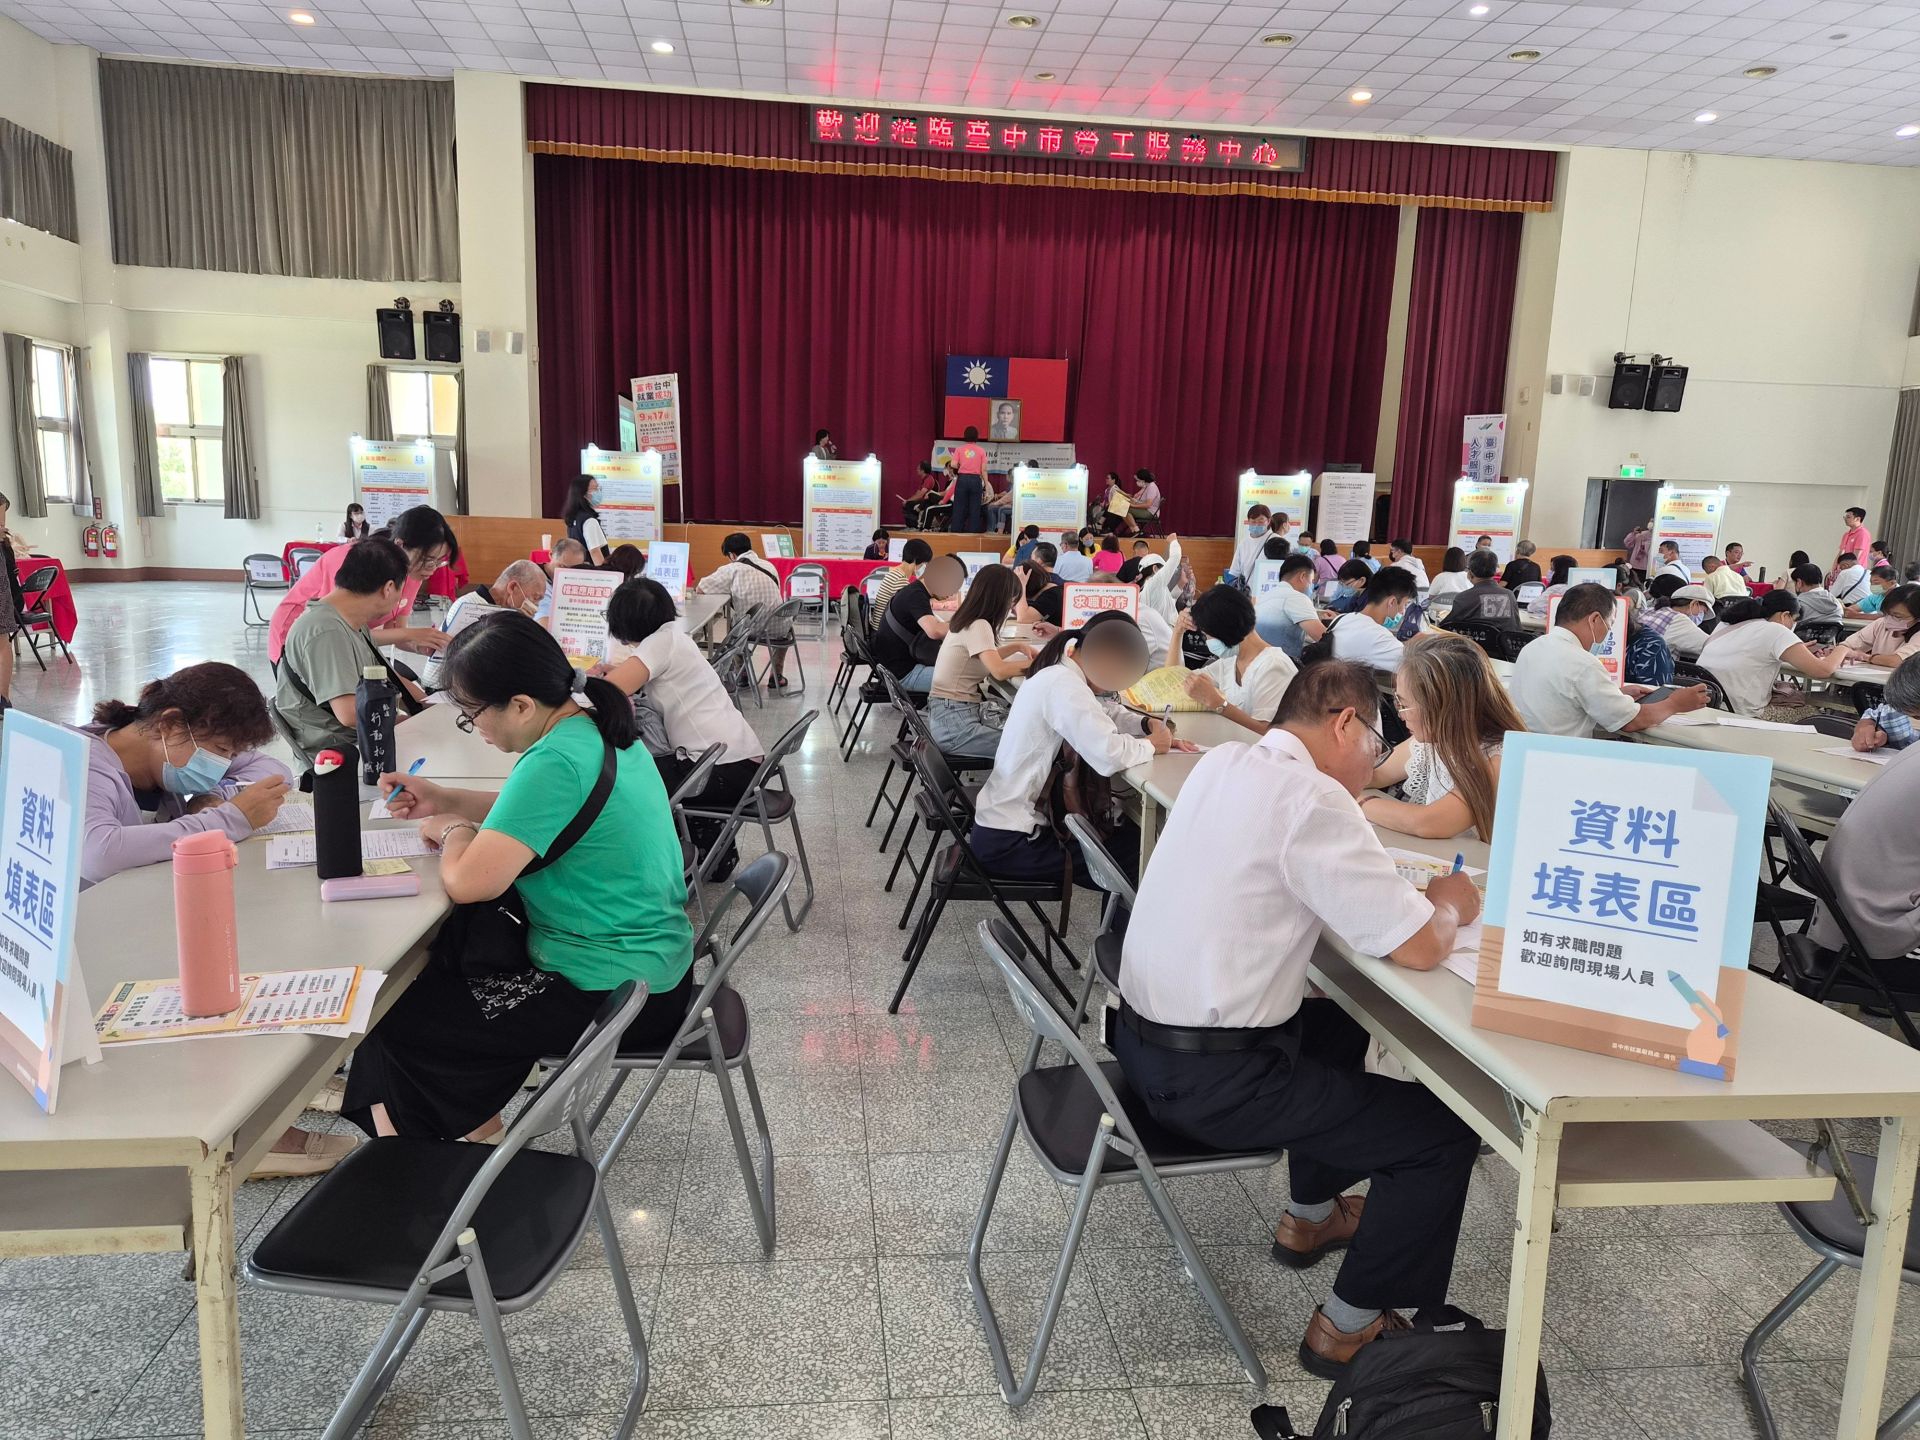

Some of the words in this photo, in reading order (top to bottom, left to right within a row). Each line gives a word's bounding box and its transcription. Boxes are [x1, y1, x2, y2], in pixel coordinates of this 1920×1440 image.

[1073, 594, 1128, 609] 求職防詐
[19, 786, 55, 854] 資料
[1568, 799, 1680, 859] 資料
[4, 857, 57, 940] 填表區
[1531, 862, 1701, 932] 填表區
[1519, 948, 1655, 987] 歡迎詢問現場人員
[1522, 929, 1623, 960] 如有求職問題
